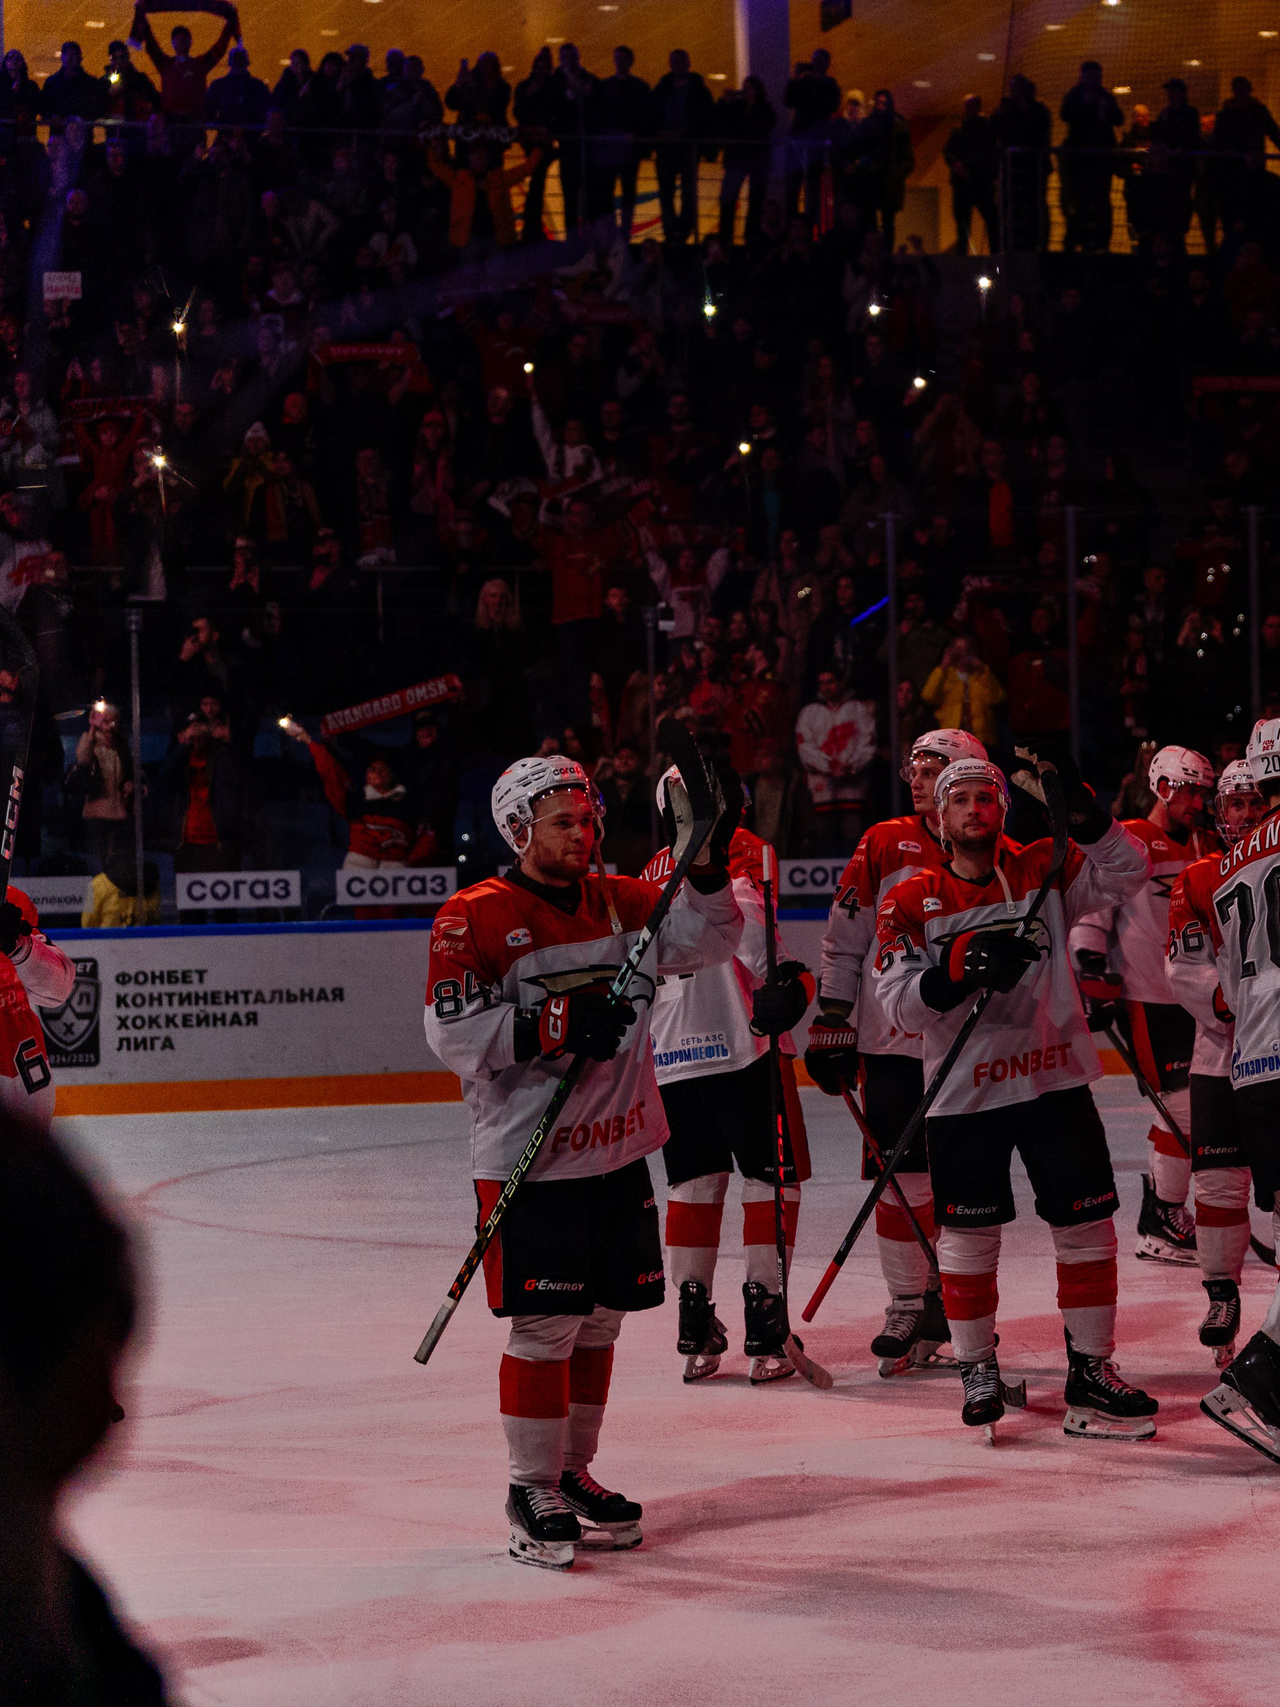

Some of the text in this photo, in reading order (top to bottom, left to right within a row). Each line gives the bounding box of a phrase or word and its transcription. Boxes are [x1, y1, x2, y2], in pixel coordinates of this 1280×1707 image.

[405, 678, 449, 705] OMSK
[1, 765, 25, 860] CCM
[788, 866, 844, 888] сог
[115, 968, 208, 986] ФОНБЕТ
[116, 986, 345, 1009] КОНТИНЕНТАЛЬНАЯ
[433, 970, 494, 1019] 84
[116, 1008, 259, 1031] ХОККЕЙНАЯ
[548, 997, 565, 1041] CC
[116, 1035, 175, 1052] ЛИГА
[681, 1033, 724, 1046] СЕТЬ АЗС
[808, 1031, 858, 1047] WARRIO
[973, 1041, 1073, 1088] FONBET
[550, 1100, 646, 1153] FONBET
[485, 1129, 544, 1238] JETSPEED
